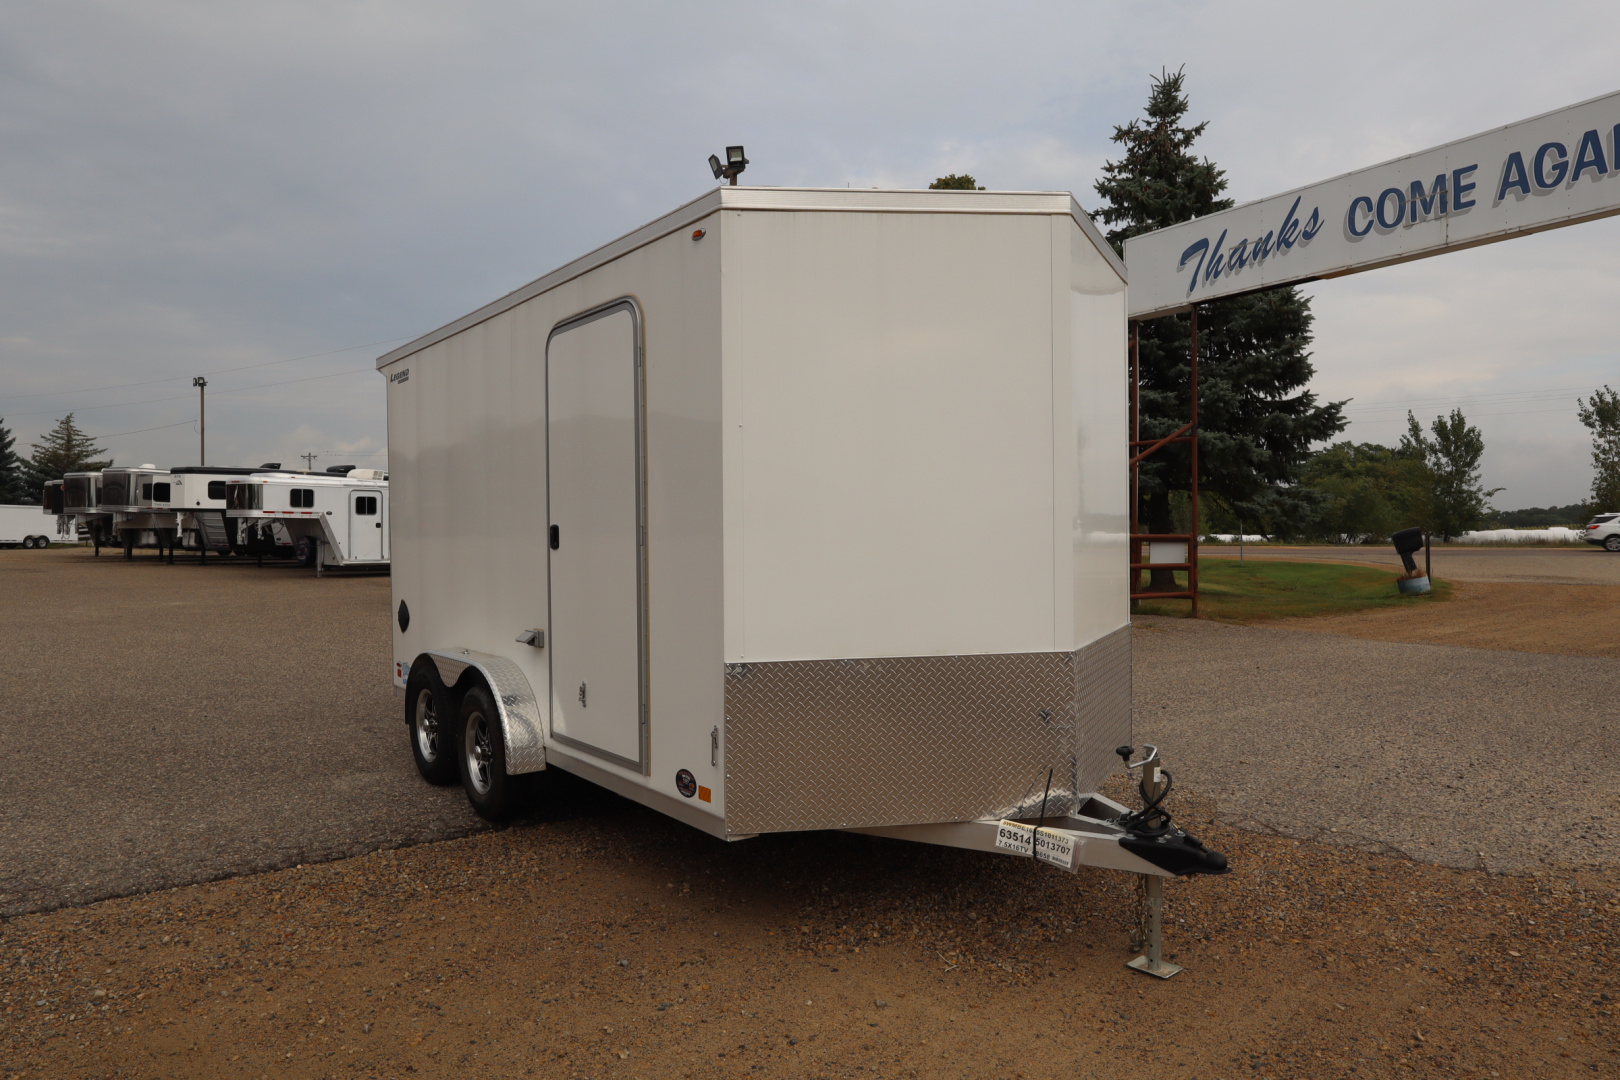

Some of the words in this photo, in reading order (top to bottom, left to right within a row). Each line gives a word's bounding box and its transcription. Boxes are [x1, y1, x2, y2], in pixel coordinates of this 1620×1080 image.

[1179, 195, 1325, 293] Thanks
[1347, 162, 1479, 237] COME
[390, 368, 409, 382] LEGEND
[999, 828, 1031, 846] 63514
